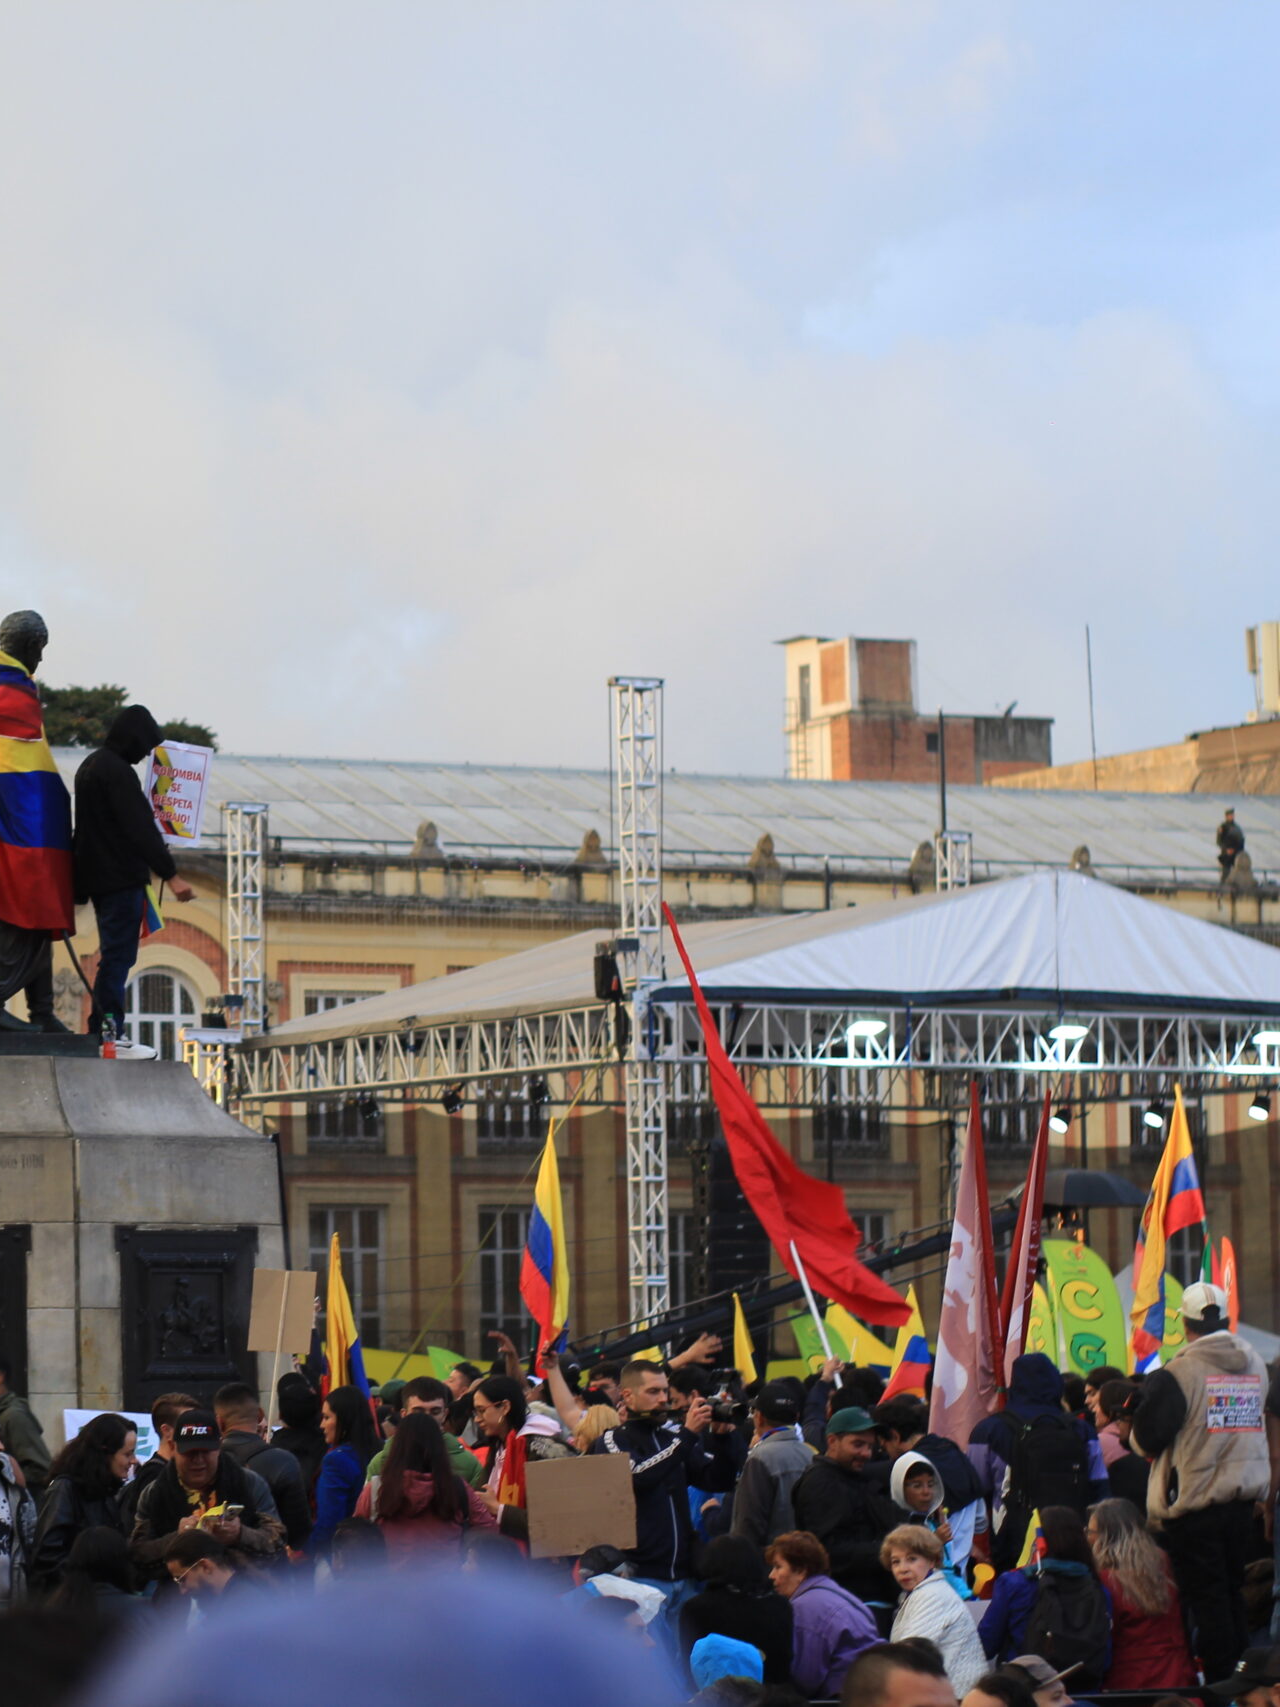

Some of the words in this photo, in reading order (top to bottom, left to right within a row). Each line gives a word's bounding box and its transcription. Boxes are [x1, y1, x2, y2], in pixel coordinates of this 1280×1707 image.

[153, 765, 203, 781] COLOMBIA
[171, 783, 182, 793] SE
[153, 794, 193, 809] RESPETA
